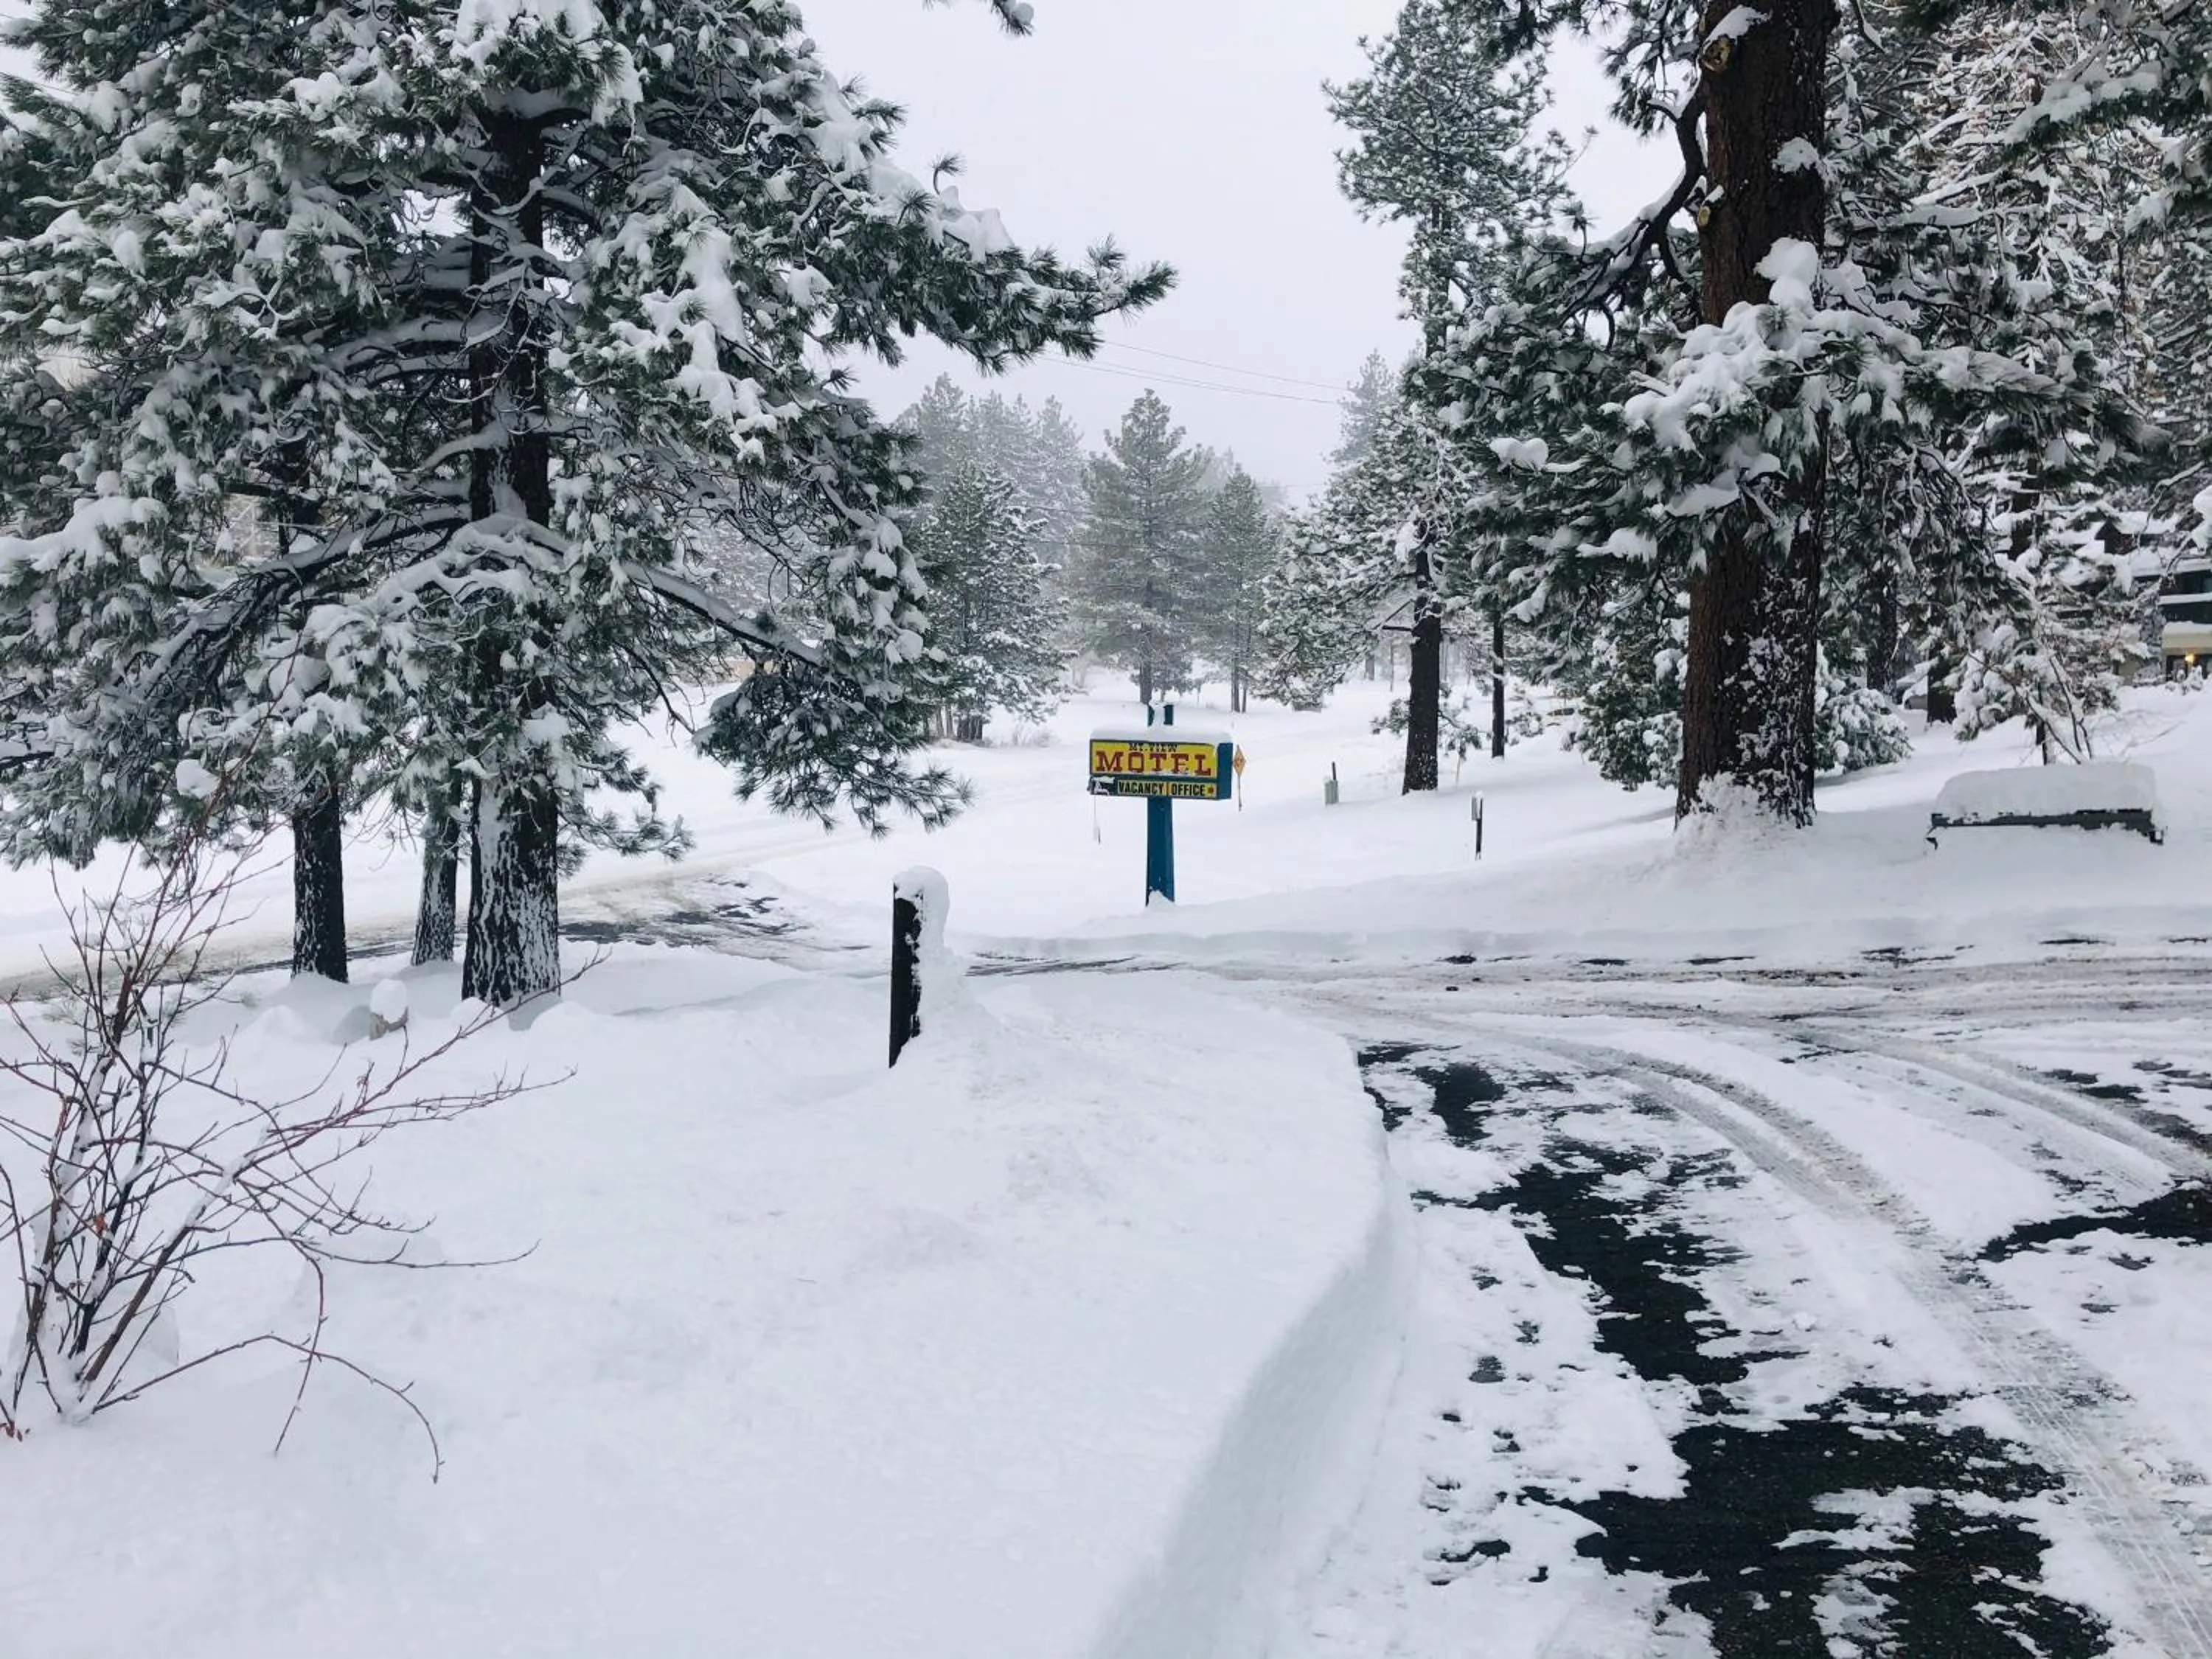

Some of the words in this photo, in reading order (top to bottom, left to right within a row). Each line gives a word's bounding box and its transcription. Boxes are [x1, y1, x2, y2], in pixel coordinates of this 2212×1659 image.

[1096, 751, 1211, 776] MOTEL
[1119, 782, 1164, 794] VACANCY
[1172, 785, 1206, 796] OFFICE
